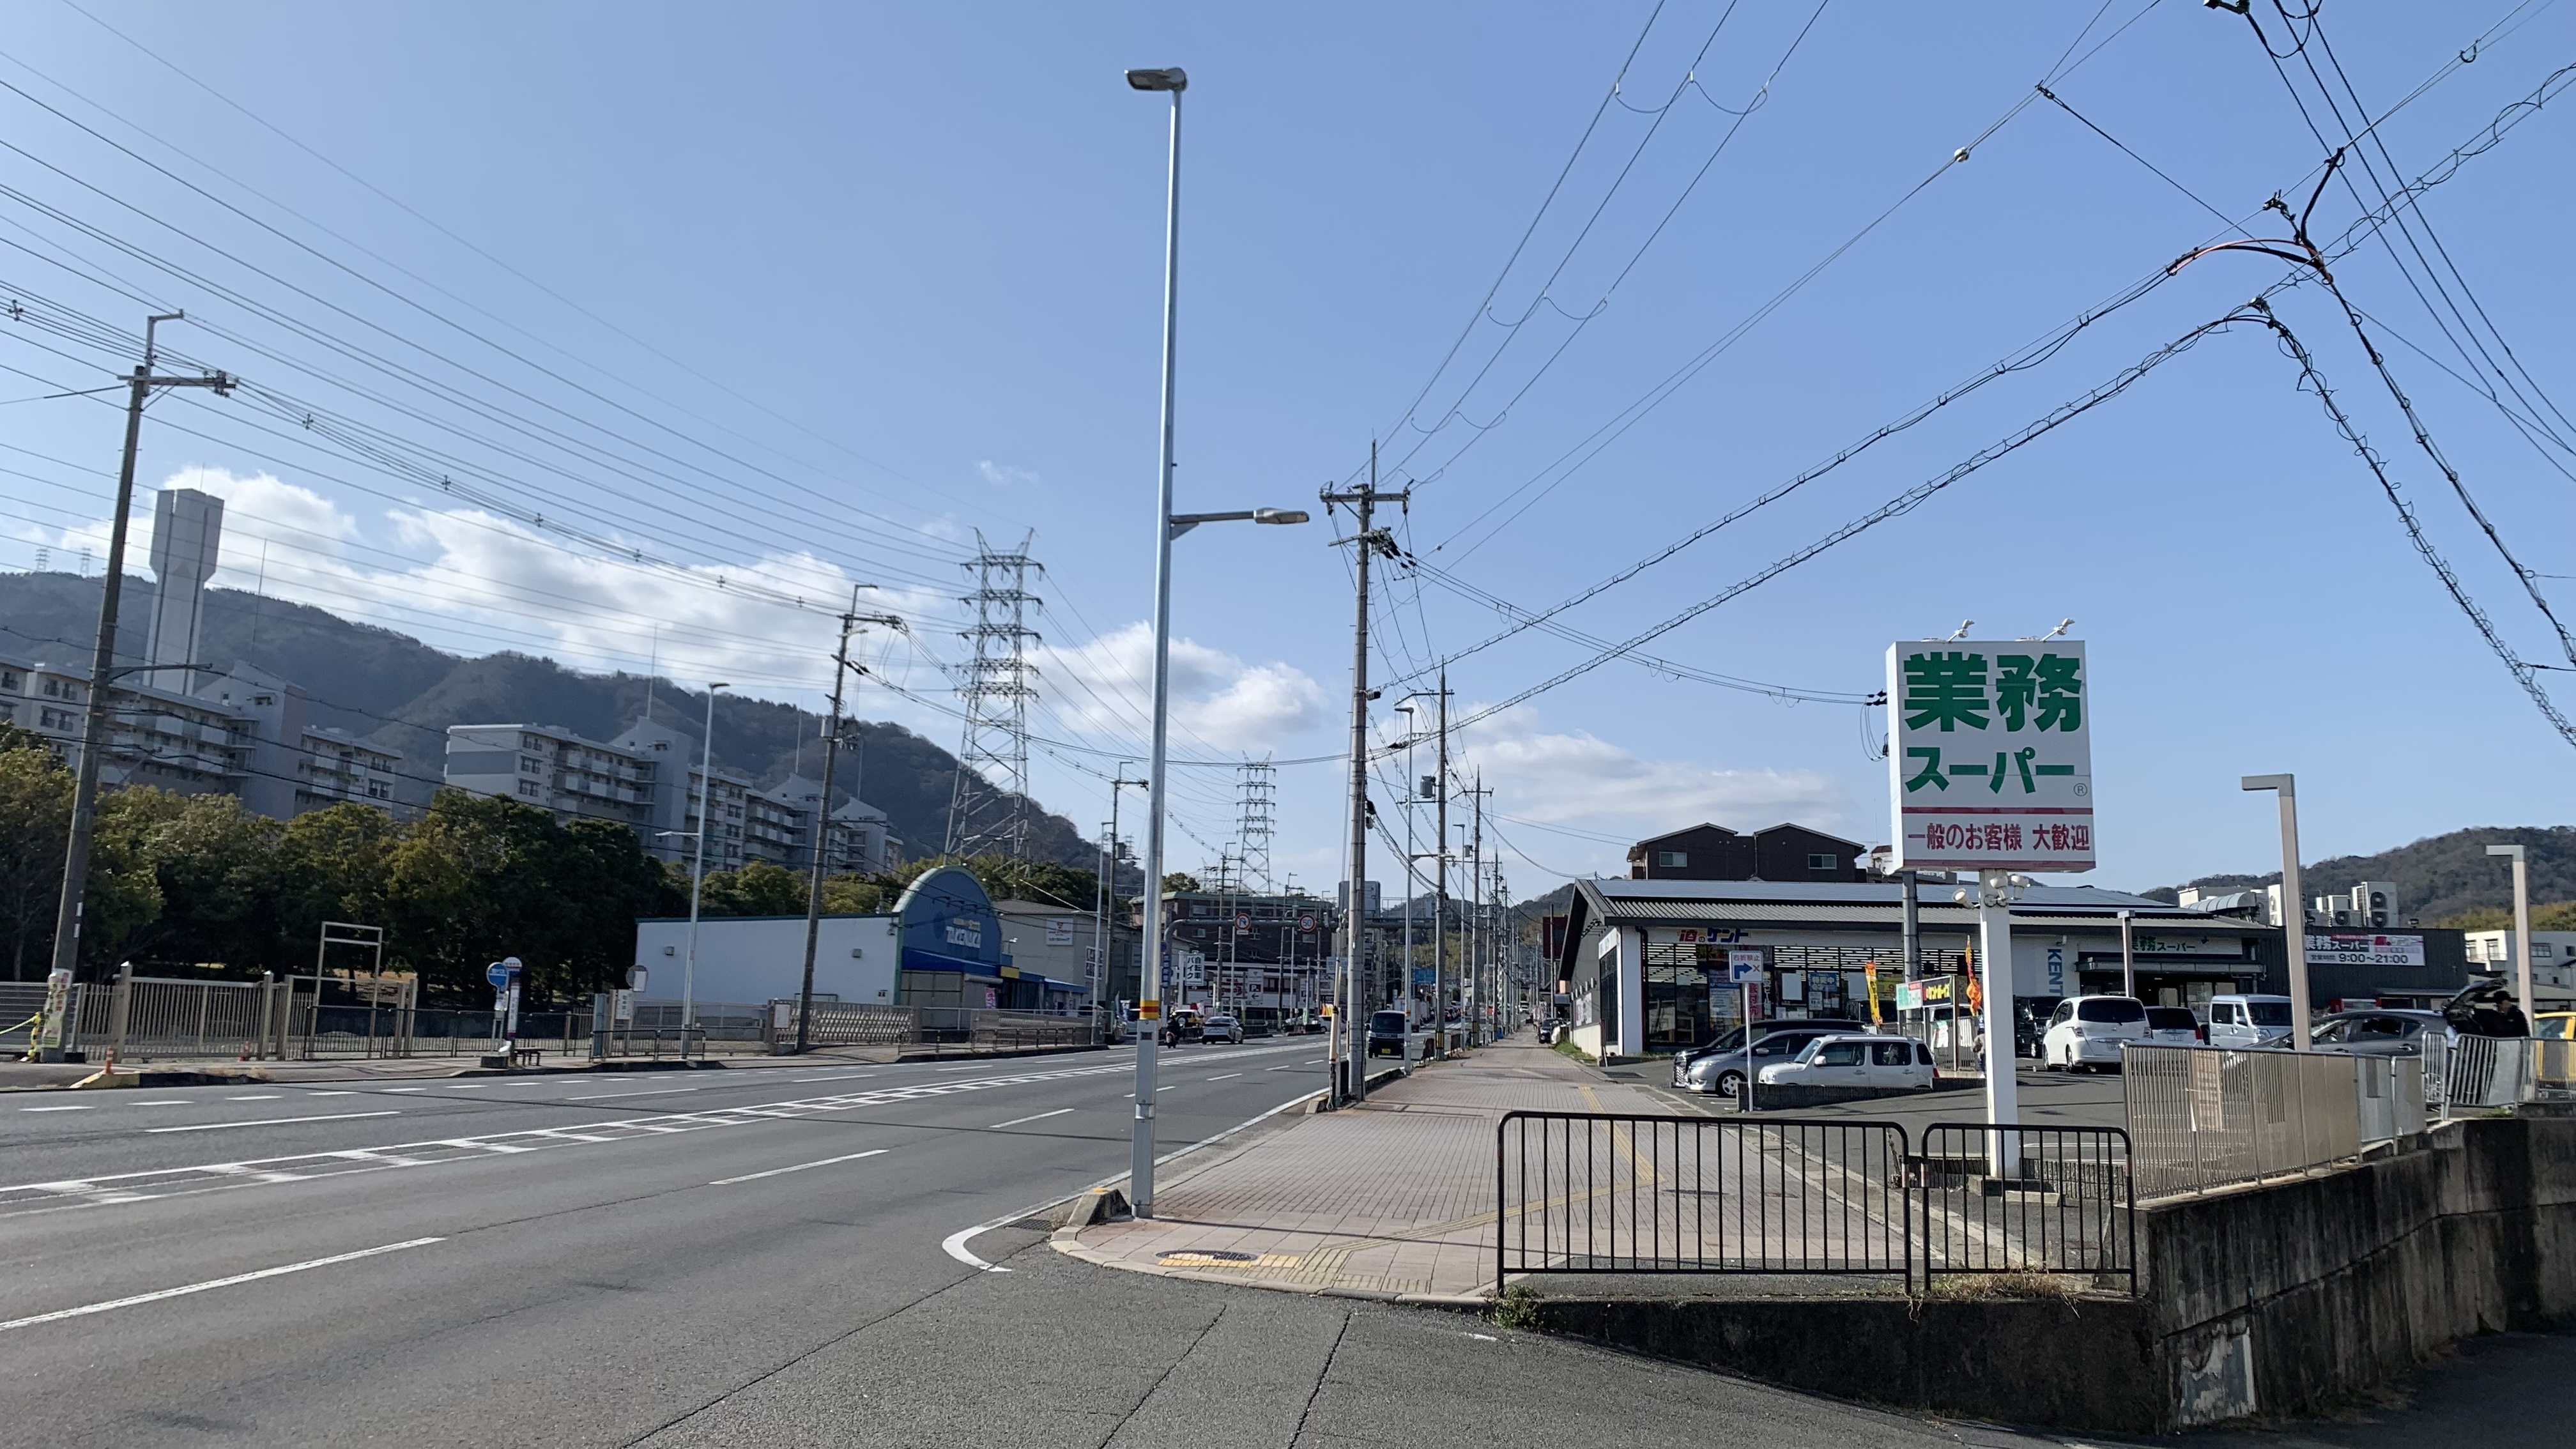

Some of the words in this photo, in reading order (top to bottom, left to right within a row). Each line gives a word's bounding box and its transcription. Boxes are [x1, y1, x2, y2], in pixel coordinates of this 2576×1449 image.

[1904, 652, 2082, 732] 業務
[1905, 747, 2074, 793] スーパー
[1908, 823, 2022, 850] 一般のお客様
[2032, 824, 2090, 851] 大歓迎
[2048, 949, 2064, 997] KENT
